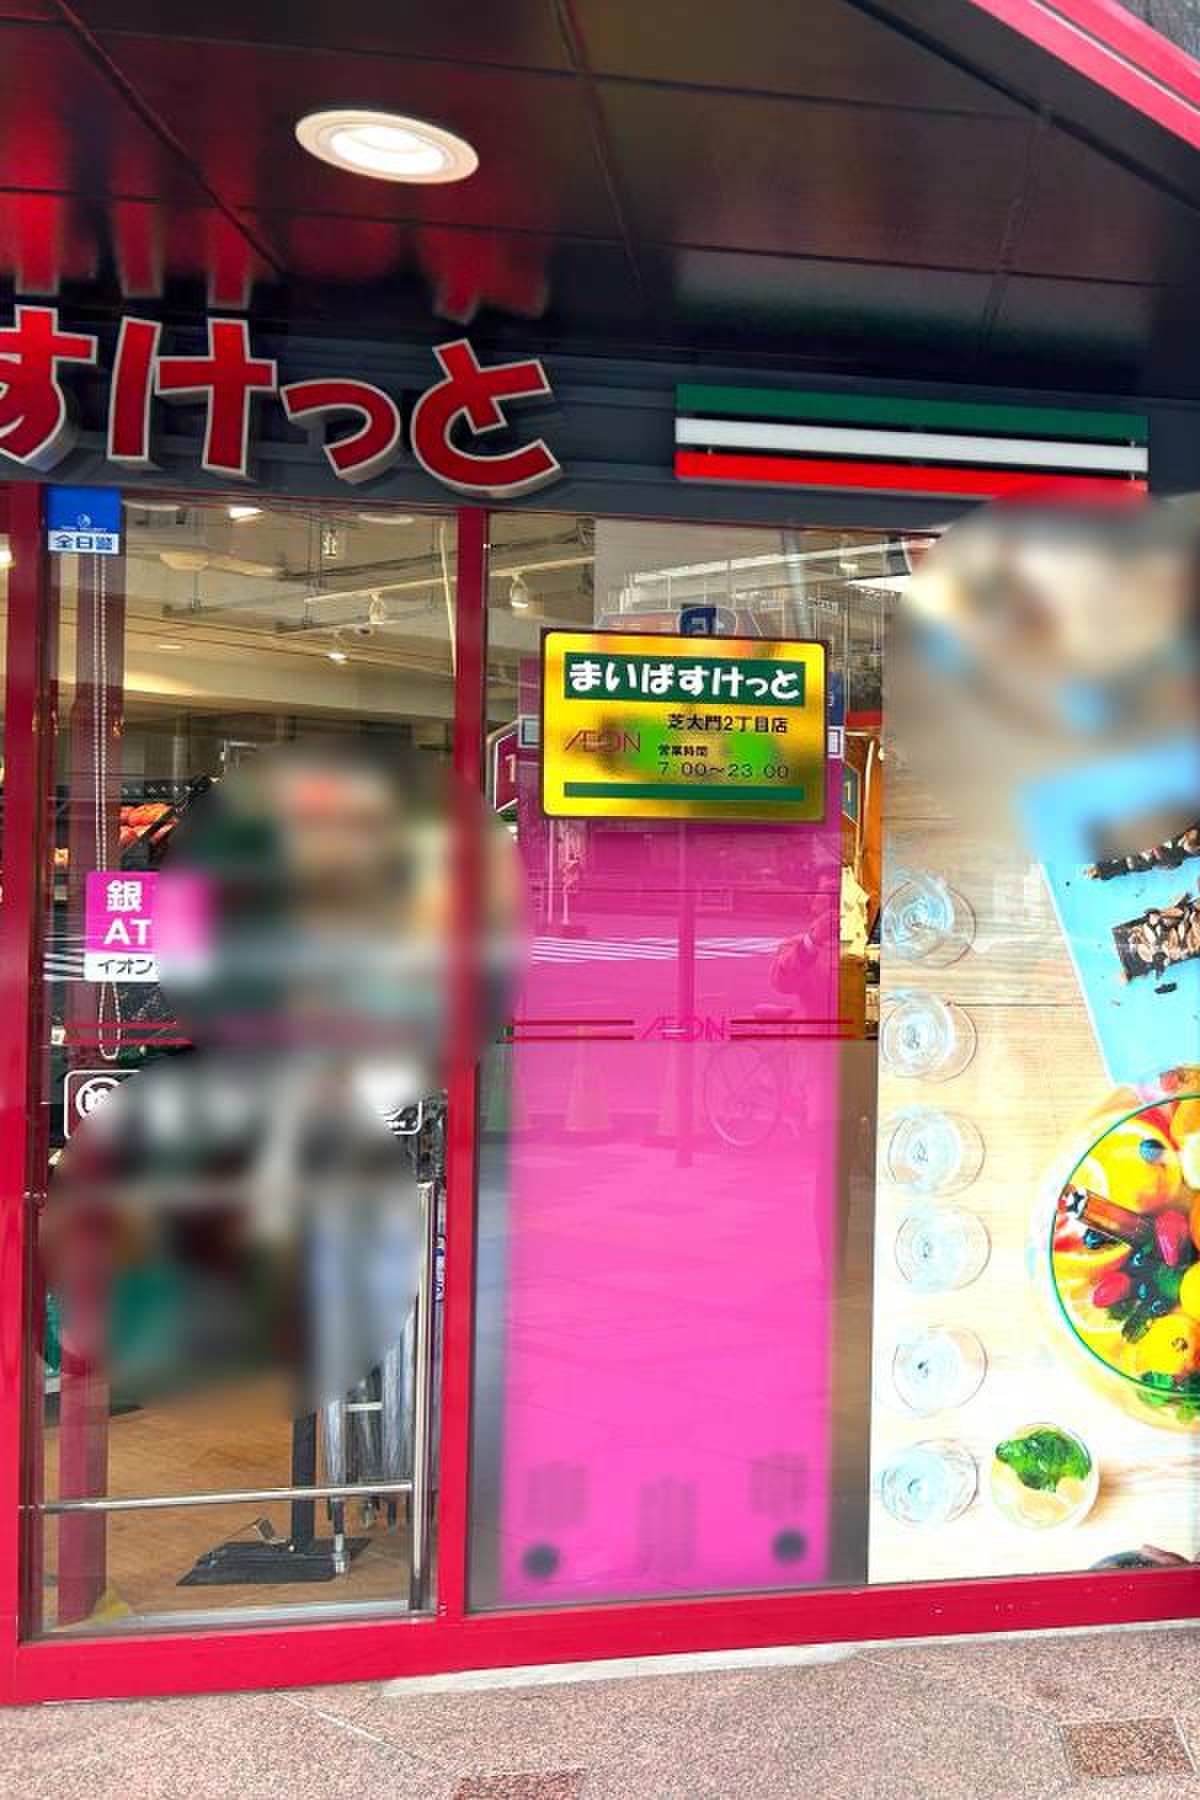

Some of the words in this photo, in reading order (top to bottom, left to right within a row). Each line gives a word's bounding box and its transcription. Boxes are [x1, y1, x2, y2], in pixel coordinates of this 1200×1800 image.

[568, 660, 800, 700] まいばすけっと
[667, 713, 788, 734] 芝大門2丁目店
[657, 743, 709, 757] 営業時間
[104, 879, 143, 913] 銀
[103, 918, 152, 945] AT
[98, 957, 154, 975] イオン
